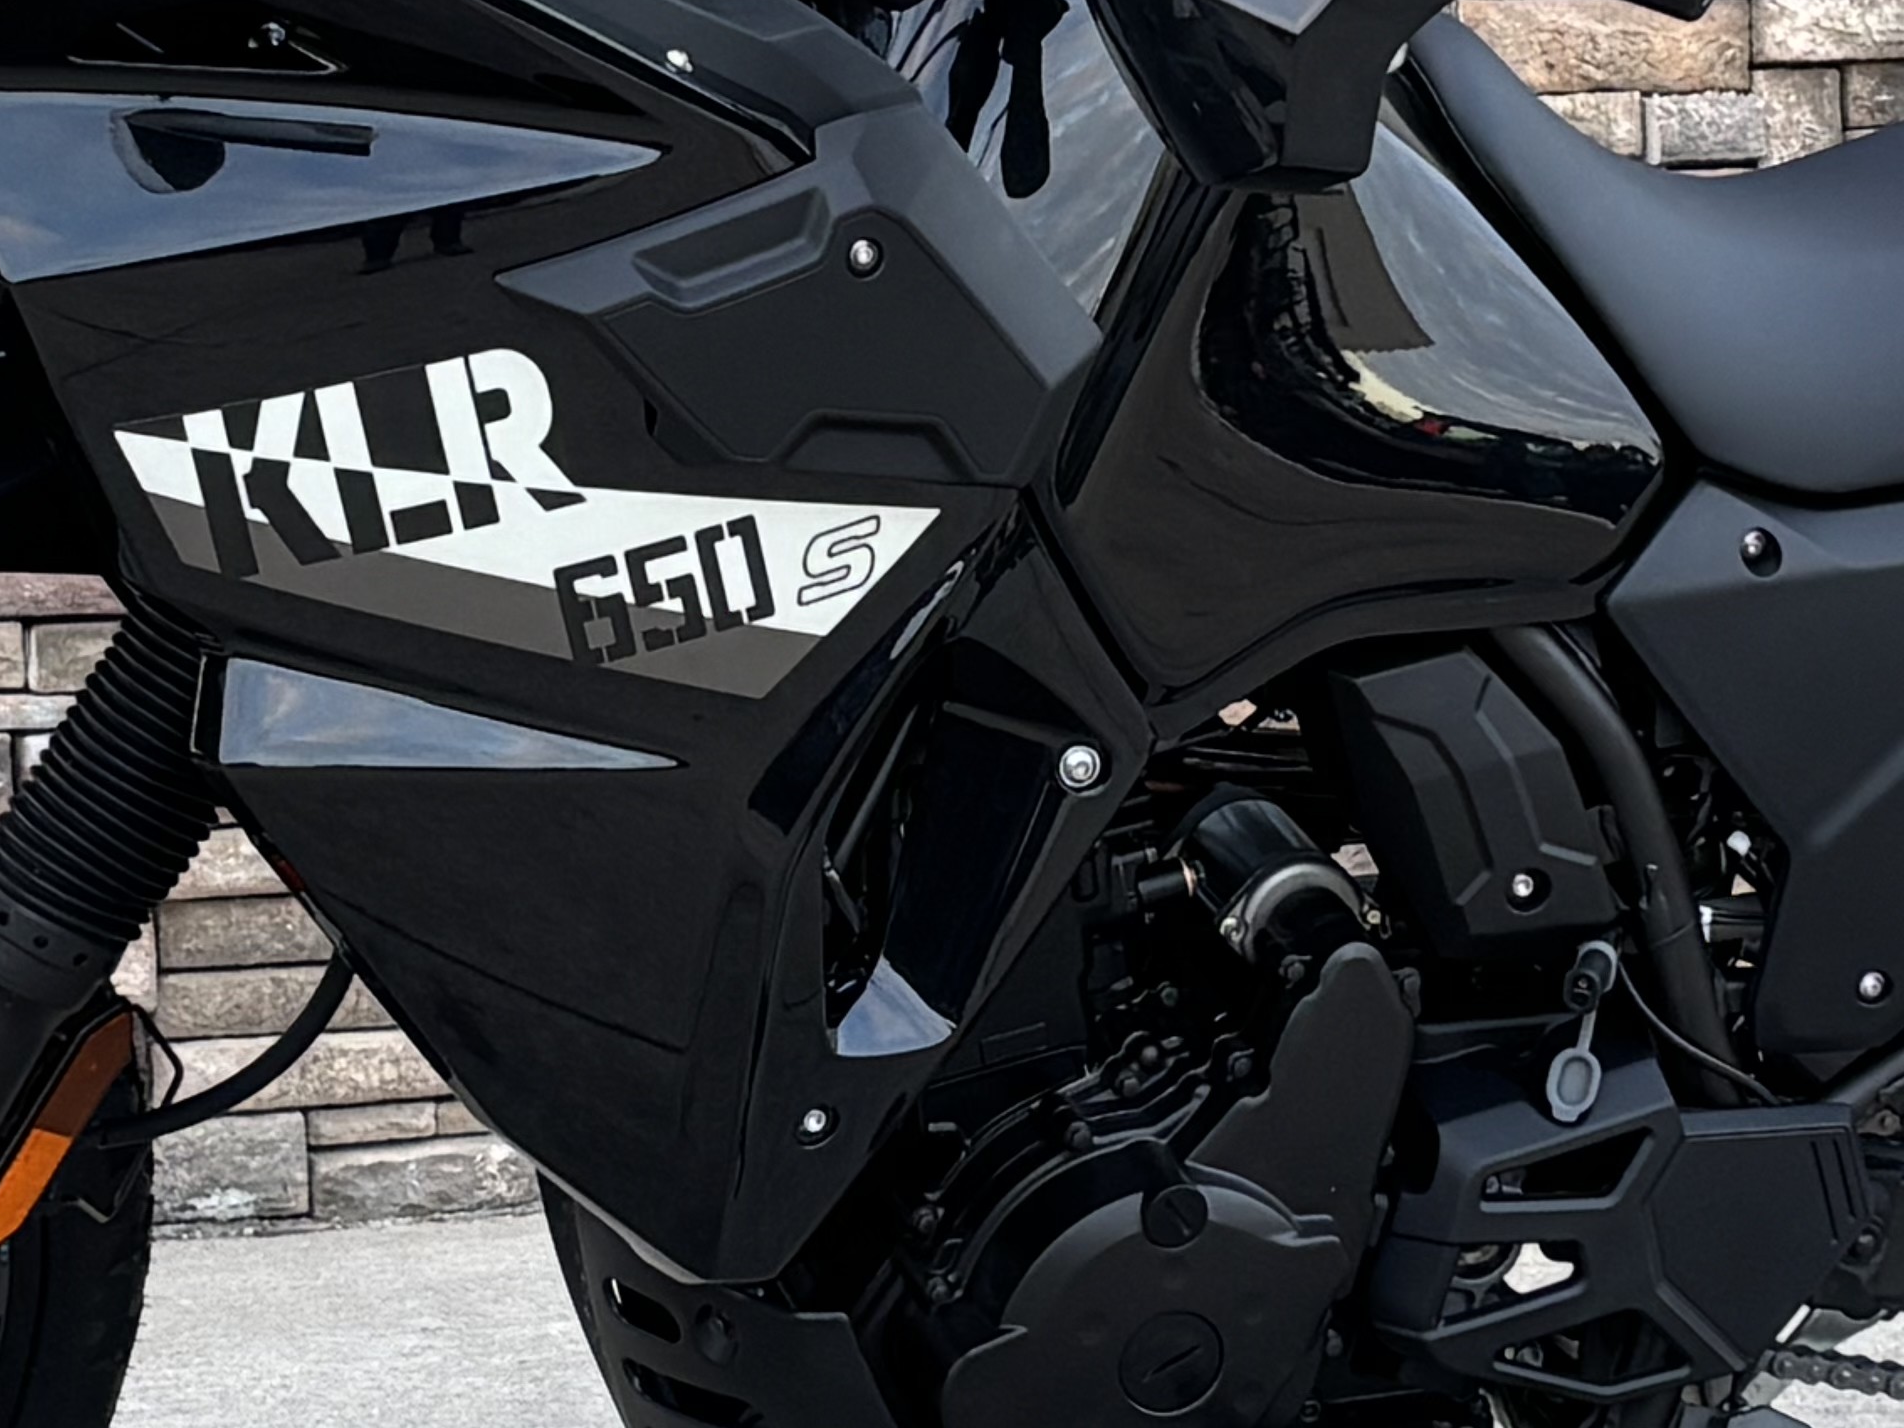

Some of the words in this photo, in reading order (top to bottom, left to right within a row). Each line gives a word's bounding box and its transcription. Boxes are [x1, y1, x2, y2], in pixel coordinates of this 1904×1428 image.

[182, 348, 586, 578] KLR
[553, 514, 775, 664] 650
[796, 515, 880, 606] S
